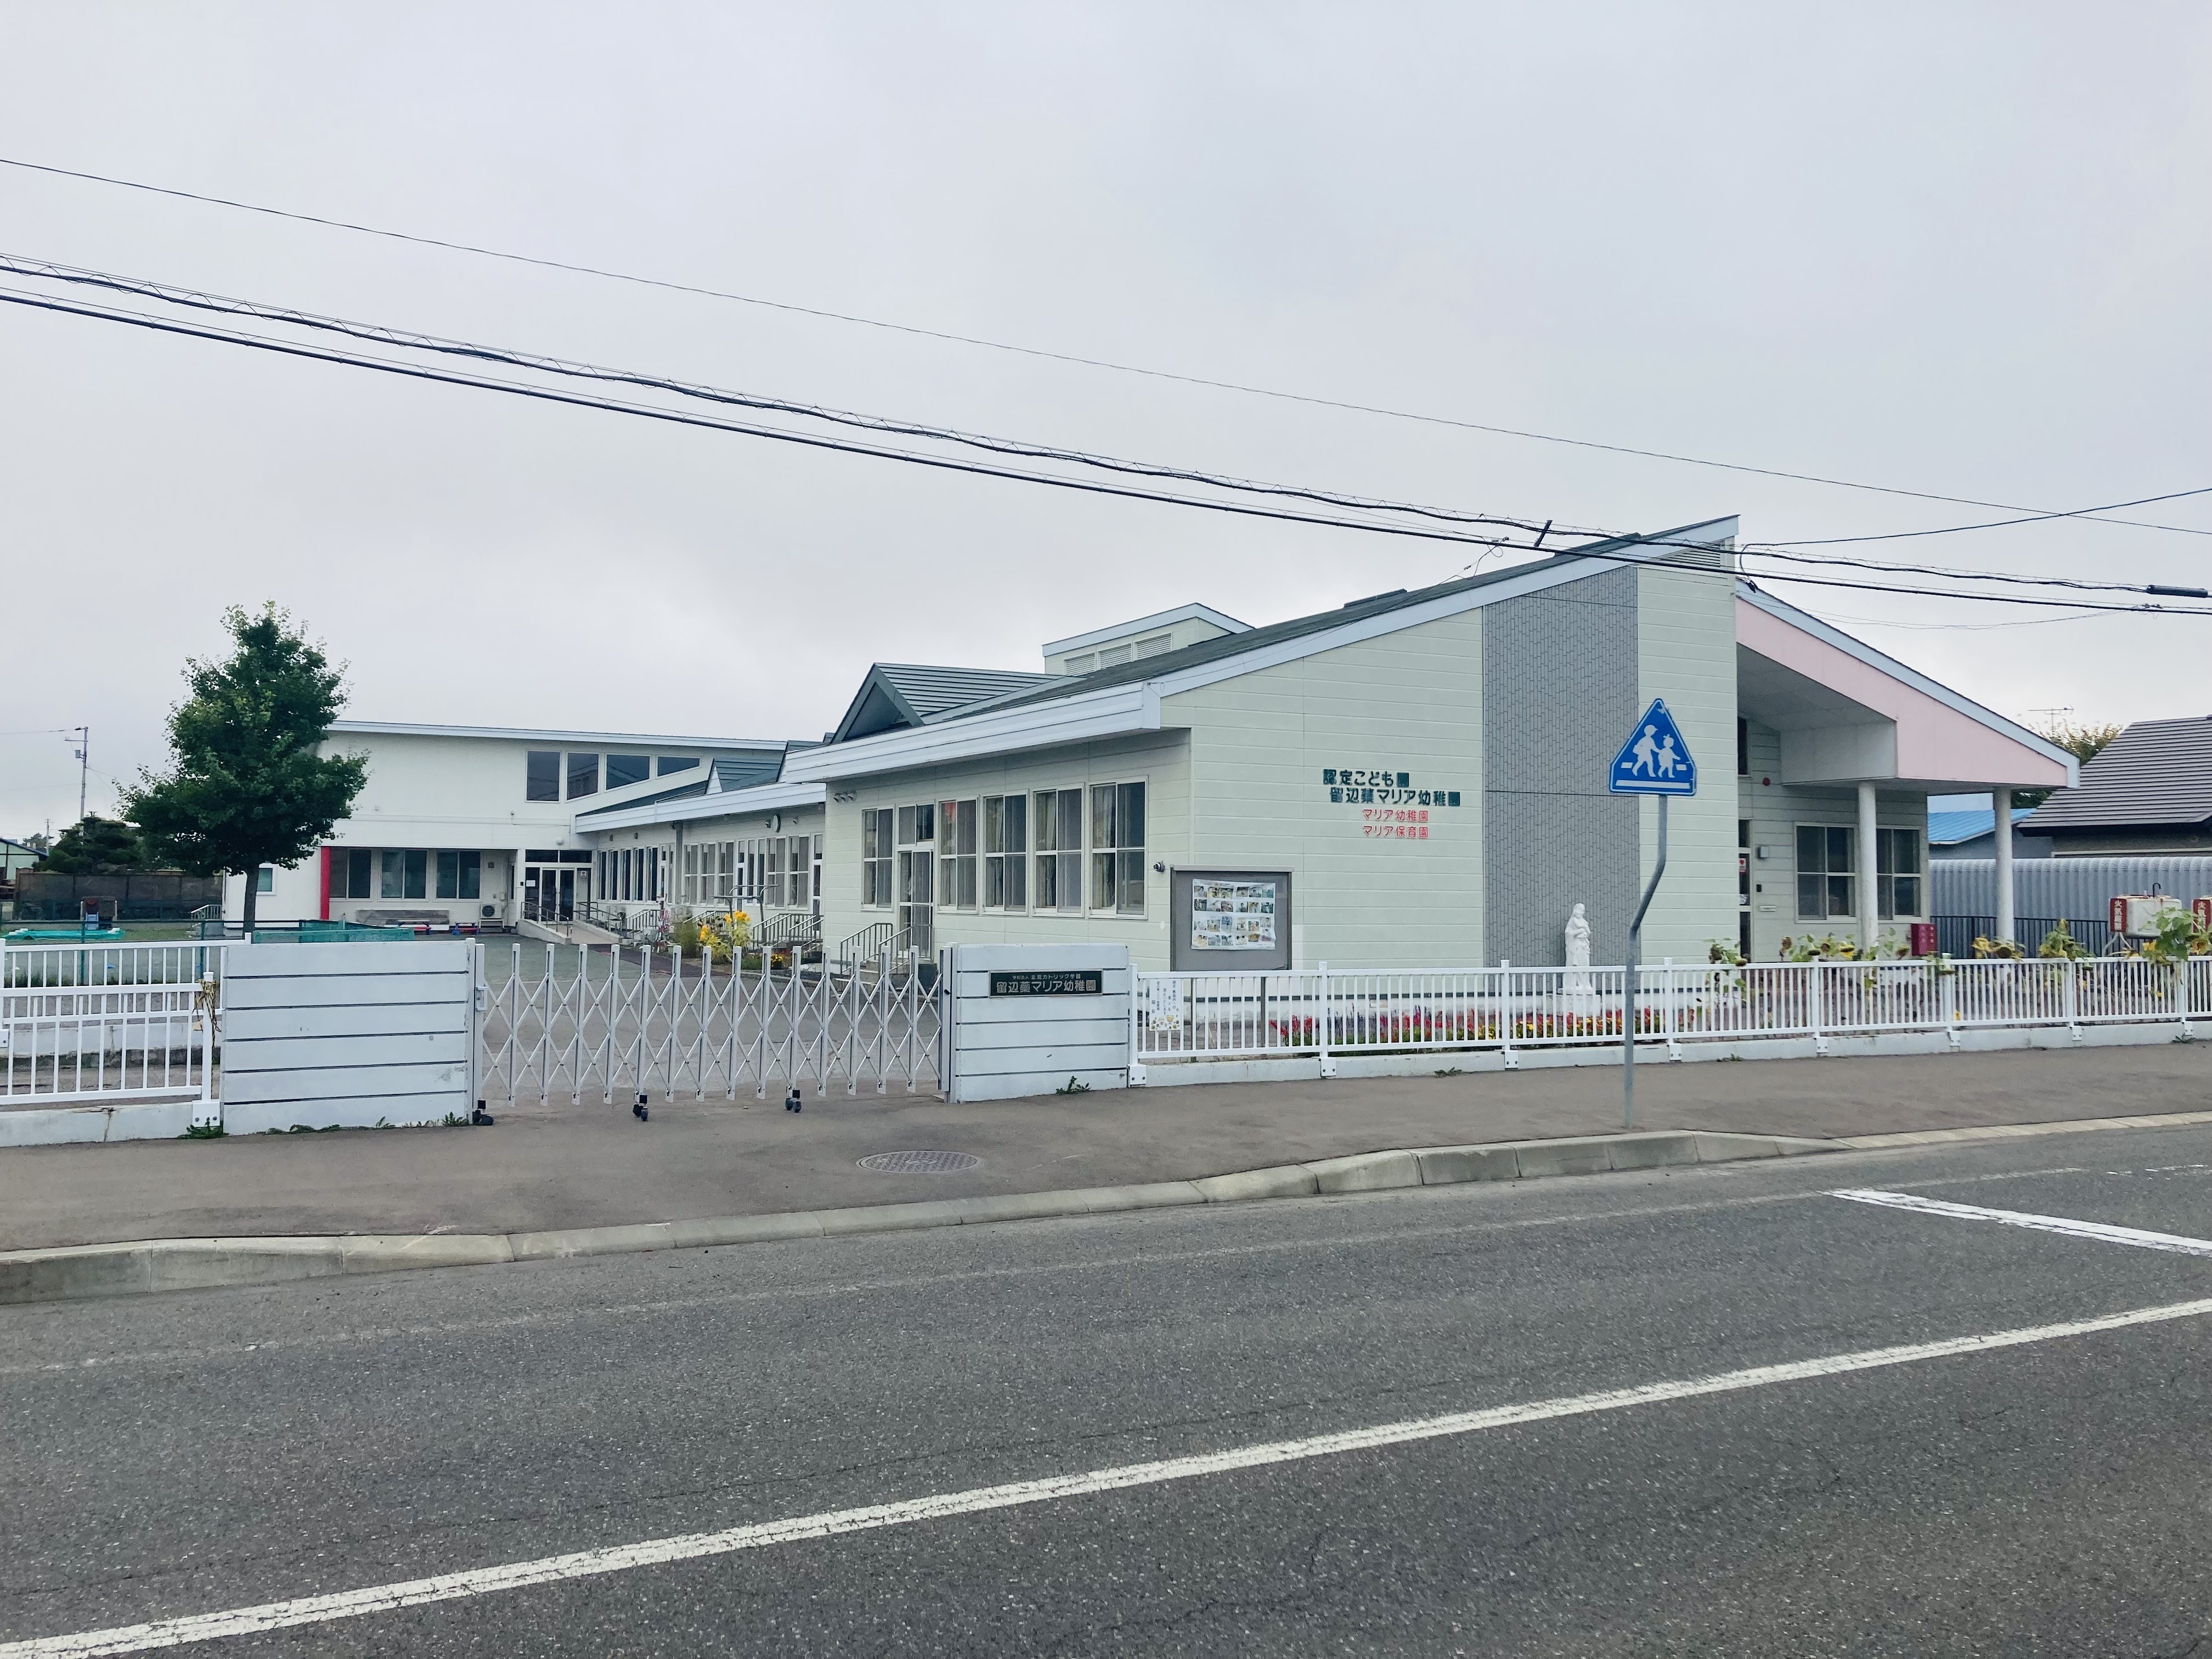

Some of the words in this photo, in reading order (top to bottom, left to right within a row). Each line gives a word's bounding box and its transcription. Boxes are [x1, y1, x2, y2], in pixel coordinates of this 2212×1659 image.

[1362, 809, 1429, 822] マリア幼稚園
[1362, 825, 1429, 839] マリア保育園
